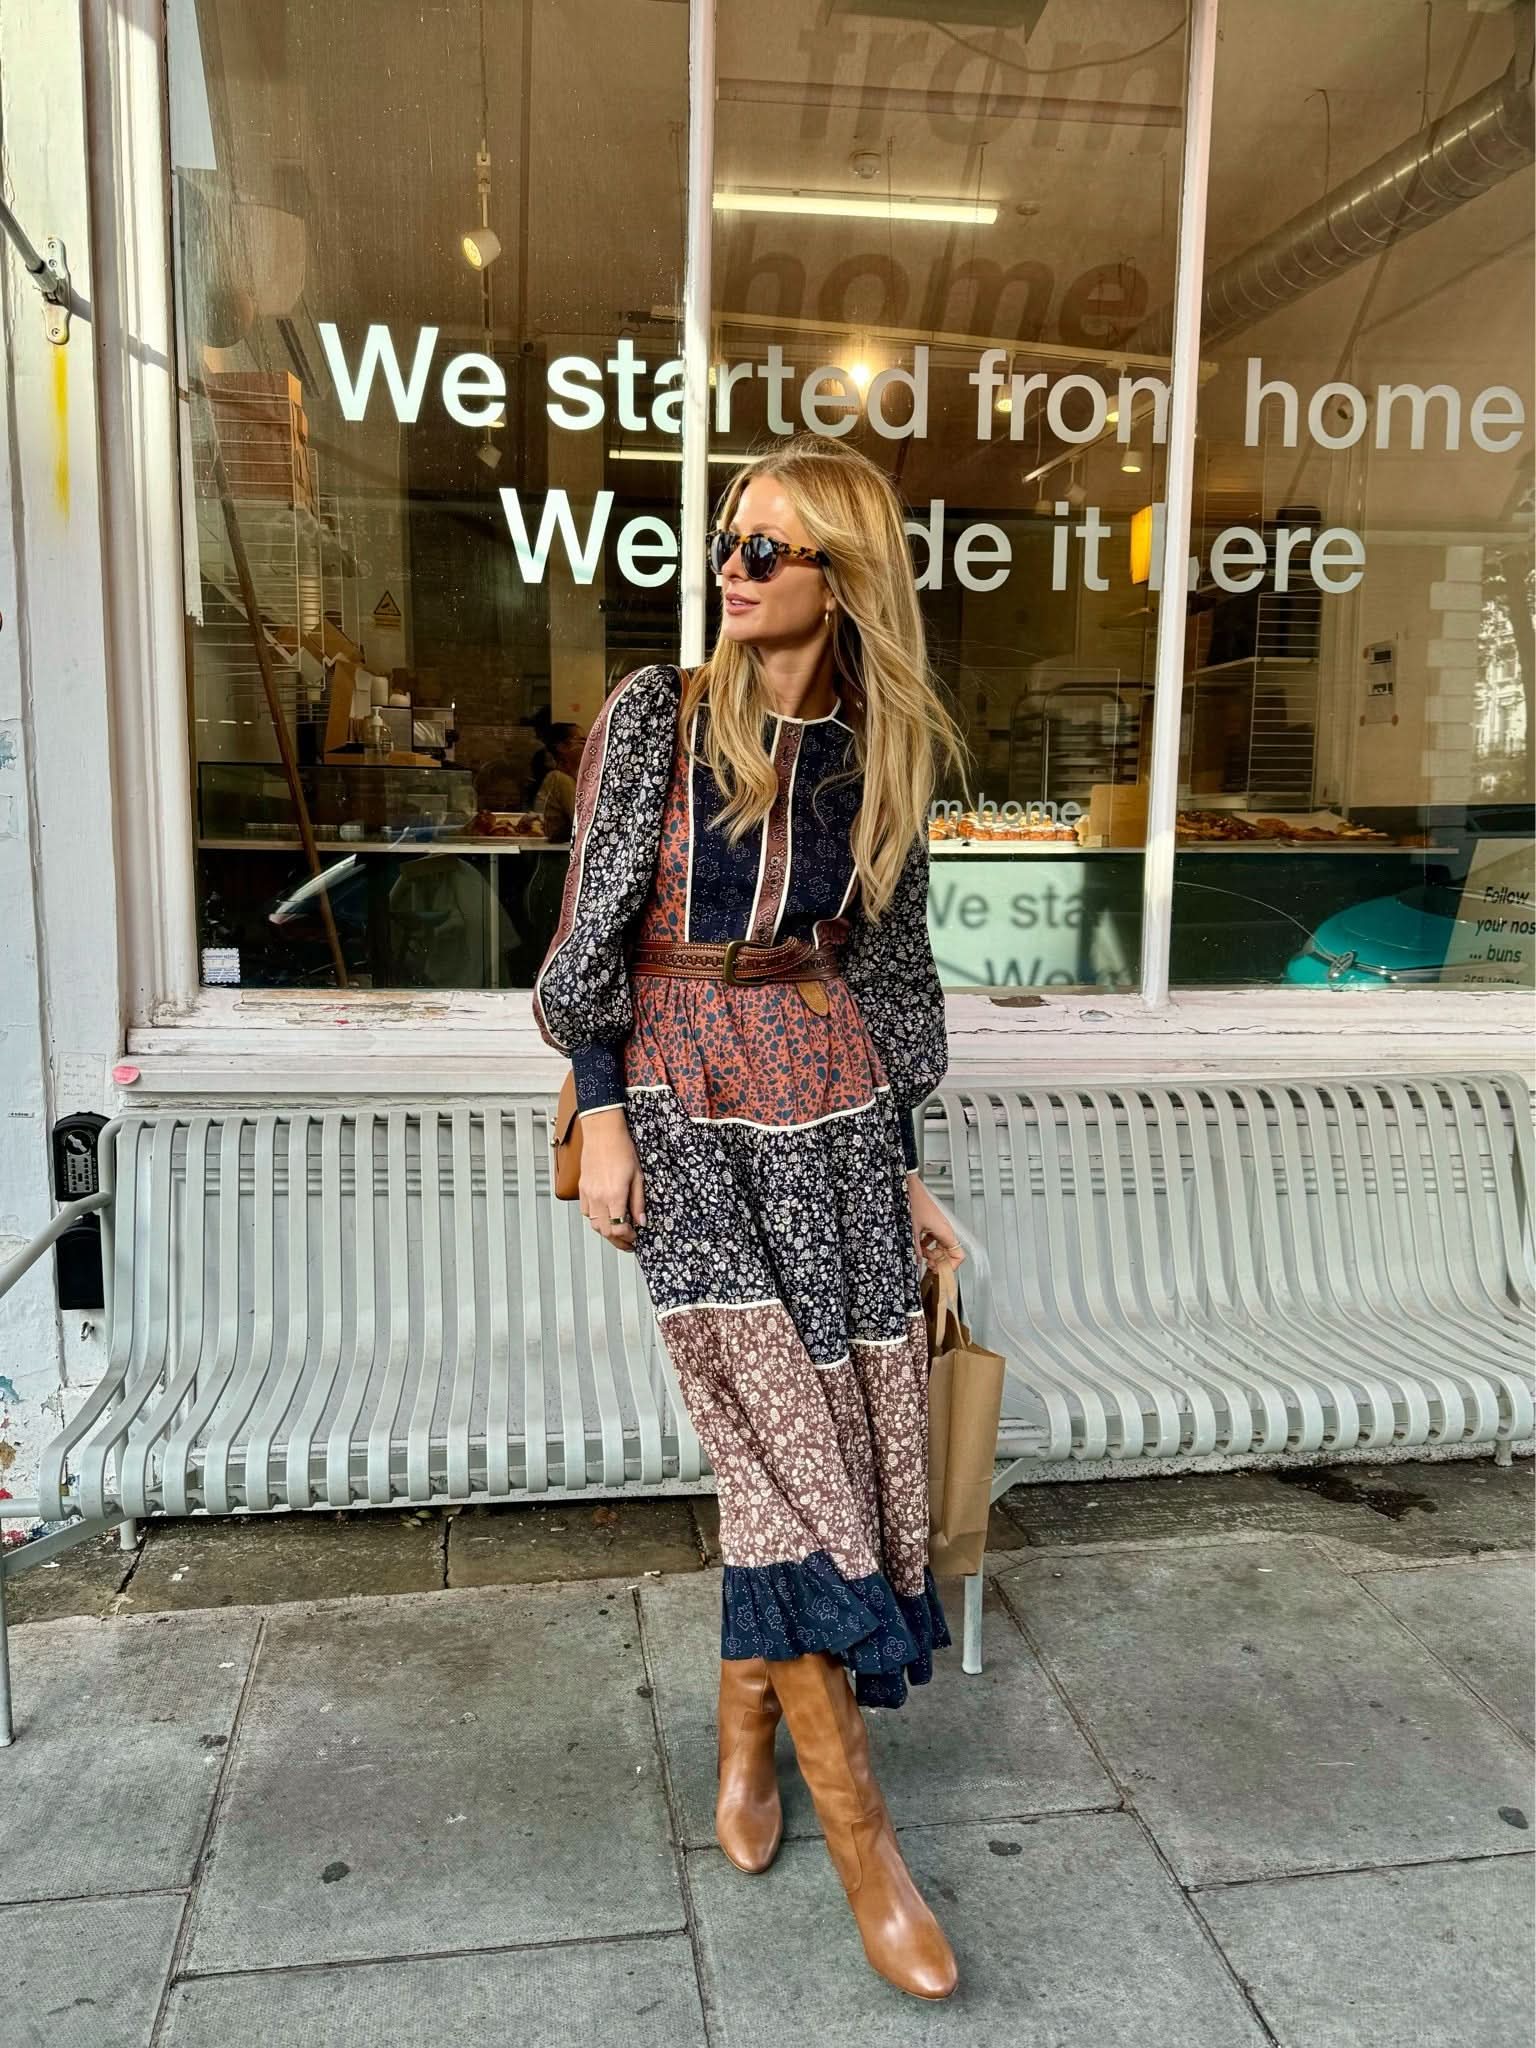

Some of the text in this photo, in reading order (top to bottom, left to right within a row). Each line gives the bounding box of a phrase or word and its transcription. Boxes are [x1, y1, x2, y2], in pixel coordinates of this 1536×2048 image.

[319, 323, 507, 427] We
[546, 338, 930, 440] started
[1245, 357, 1526, 453] home
[499, 487, 678, 588] We
[1052, 501, 1111, 592] it
[977, 792, 1082, 826] home
[1483, 886, 1530, 904] Follow
[1475, 918, 1507, 936] your
[1486, 944, 1522, 962] buns
